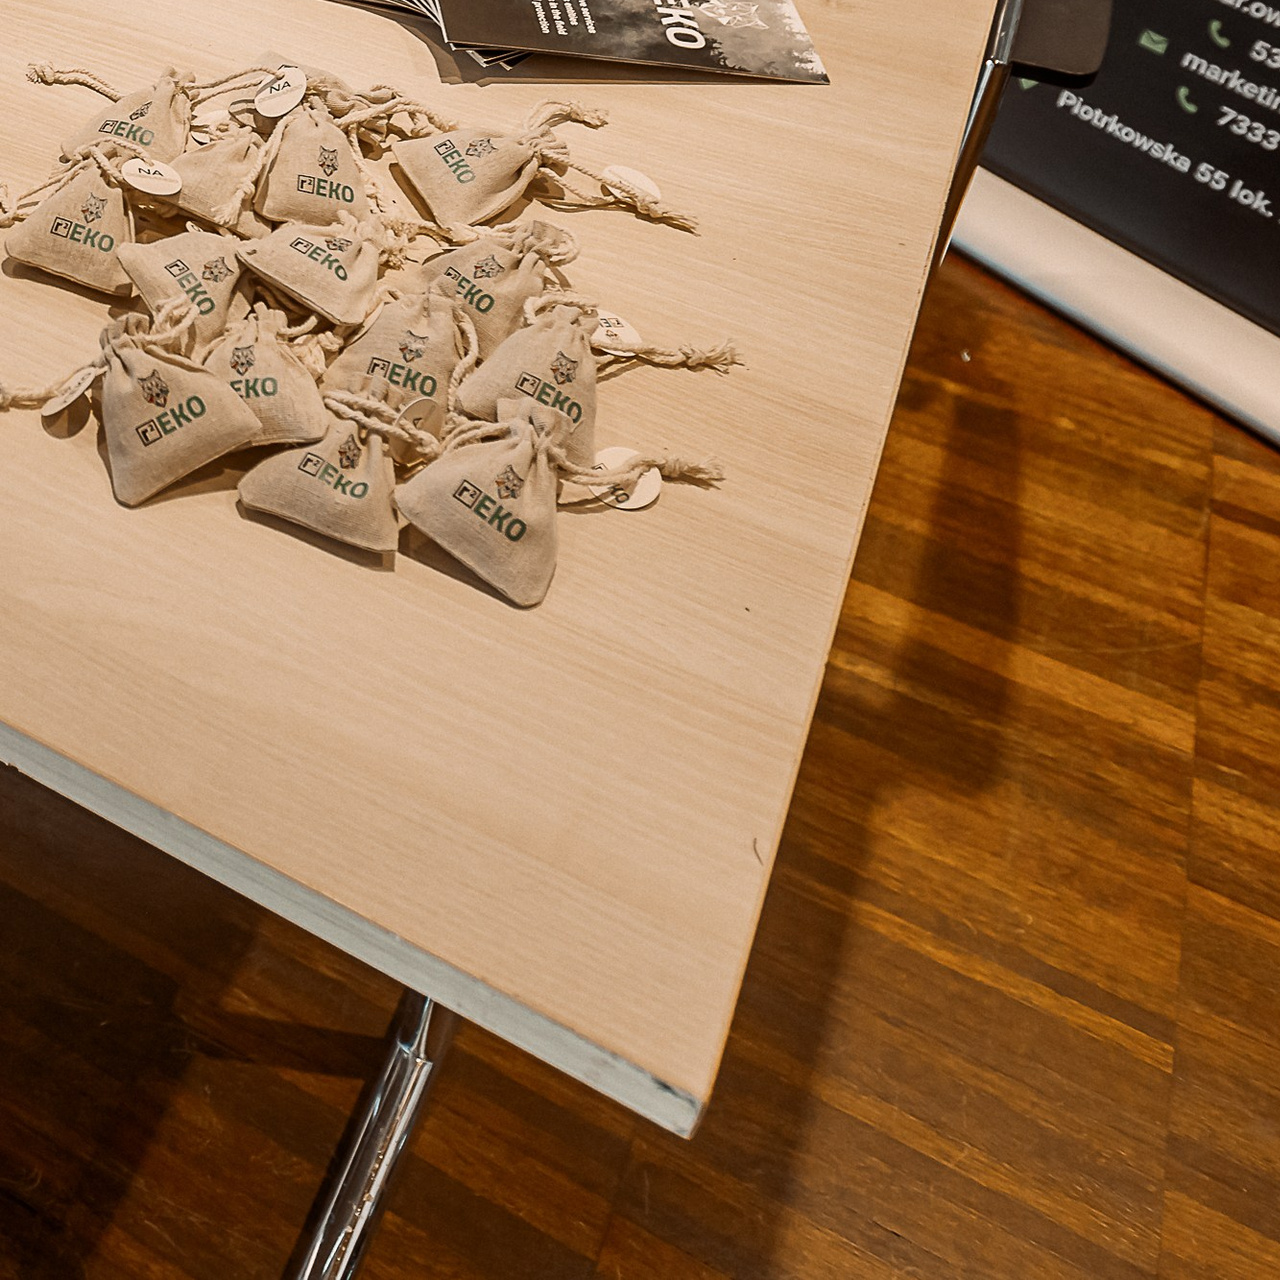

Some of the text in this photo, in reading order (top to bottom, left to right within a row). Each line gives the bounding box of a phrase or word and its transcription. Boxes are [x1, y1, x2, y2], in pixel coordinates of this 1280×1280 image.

[551, 9, 561, 20] the
[581, 7, 596, 34] services
[554, 20, 568, 35] field
[269, 80, 291, 94] NA
[1217, 105, 1280, 151] 7333
[1056, 89, 1273, 218] Piotrkowska 55 lok.
[138, 167, 164, 177] NA
